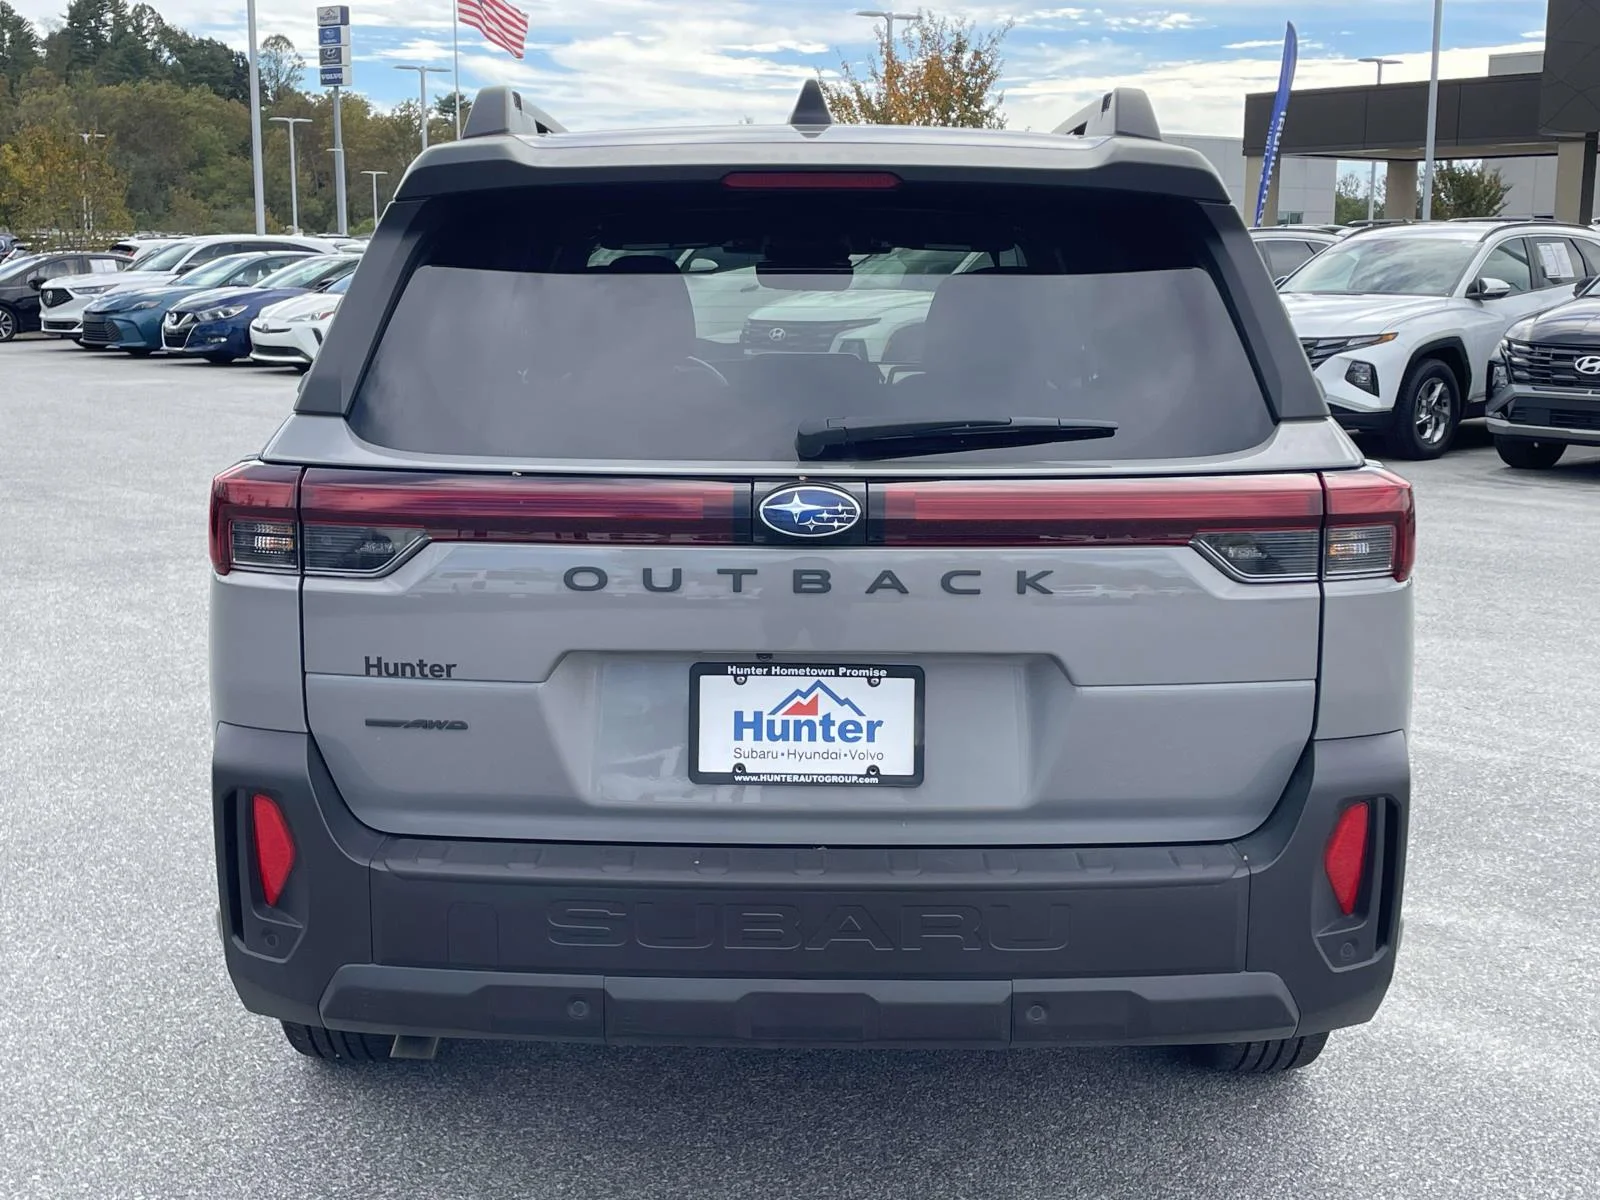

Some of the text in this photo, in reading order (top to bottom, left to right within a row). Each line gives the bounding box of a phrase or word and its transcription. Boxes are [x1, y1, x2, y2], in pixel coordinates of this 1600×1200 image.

[563, 566, 1054, 595] OUTBACK
[364, 656, 457, 678] Hunter
[727, 665, 887, 677] Hunter Hometown Promise
[403, 719, 468, 730] AWD
[733, 711, 884, 743] Hunter
[734, 774, 879, 784] www.HUNTERAUTOGROUP.com
[546, 901, 1073, 951] SUBARU
